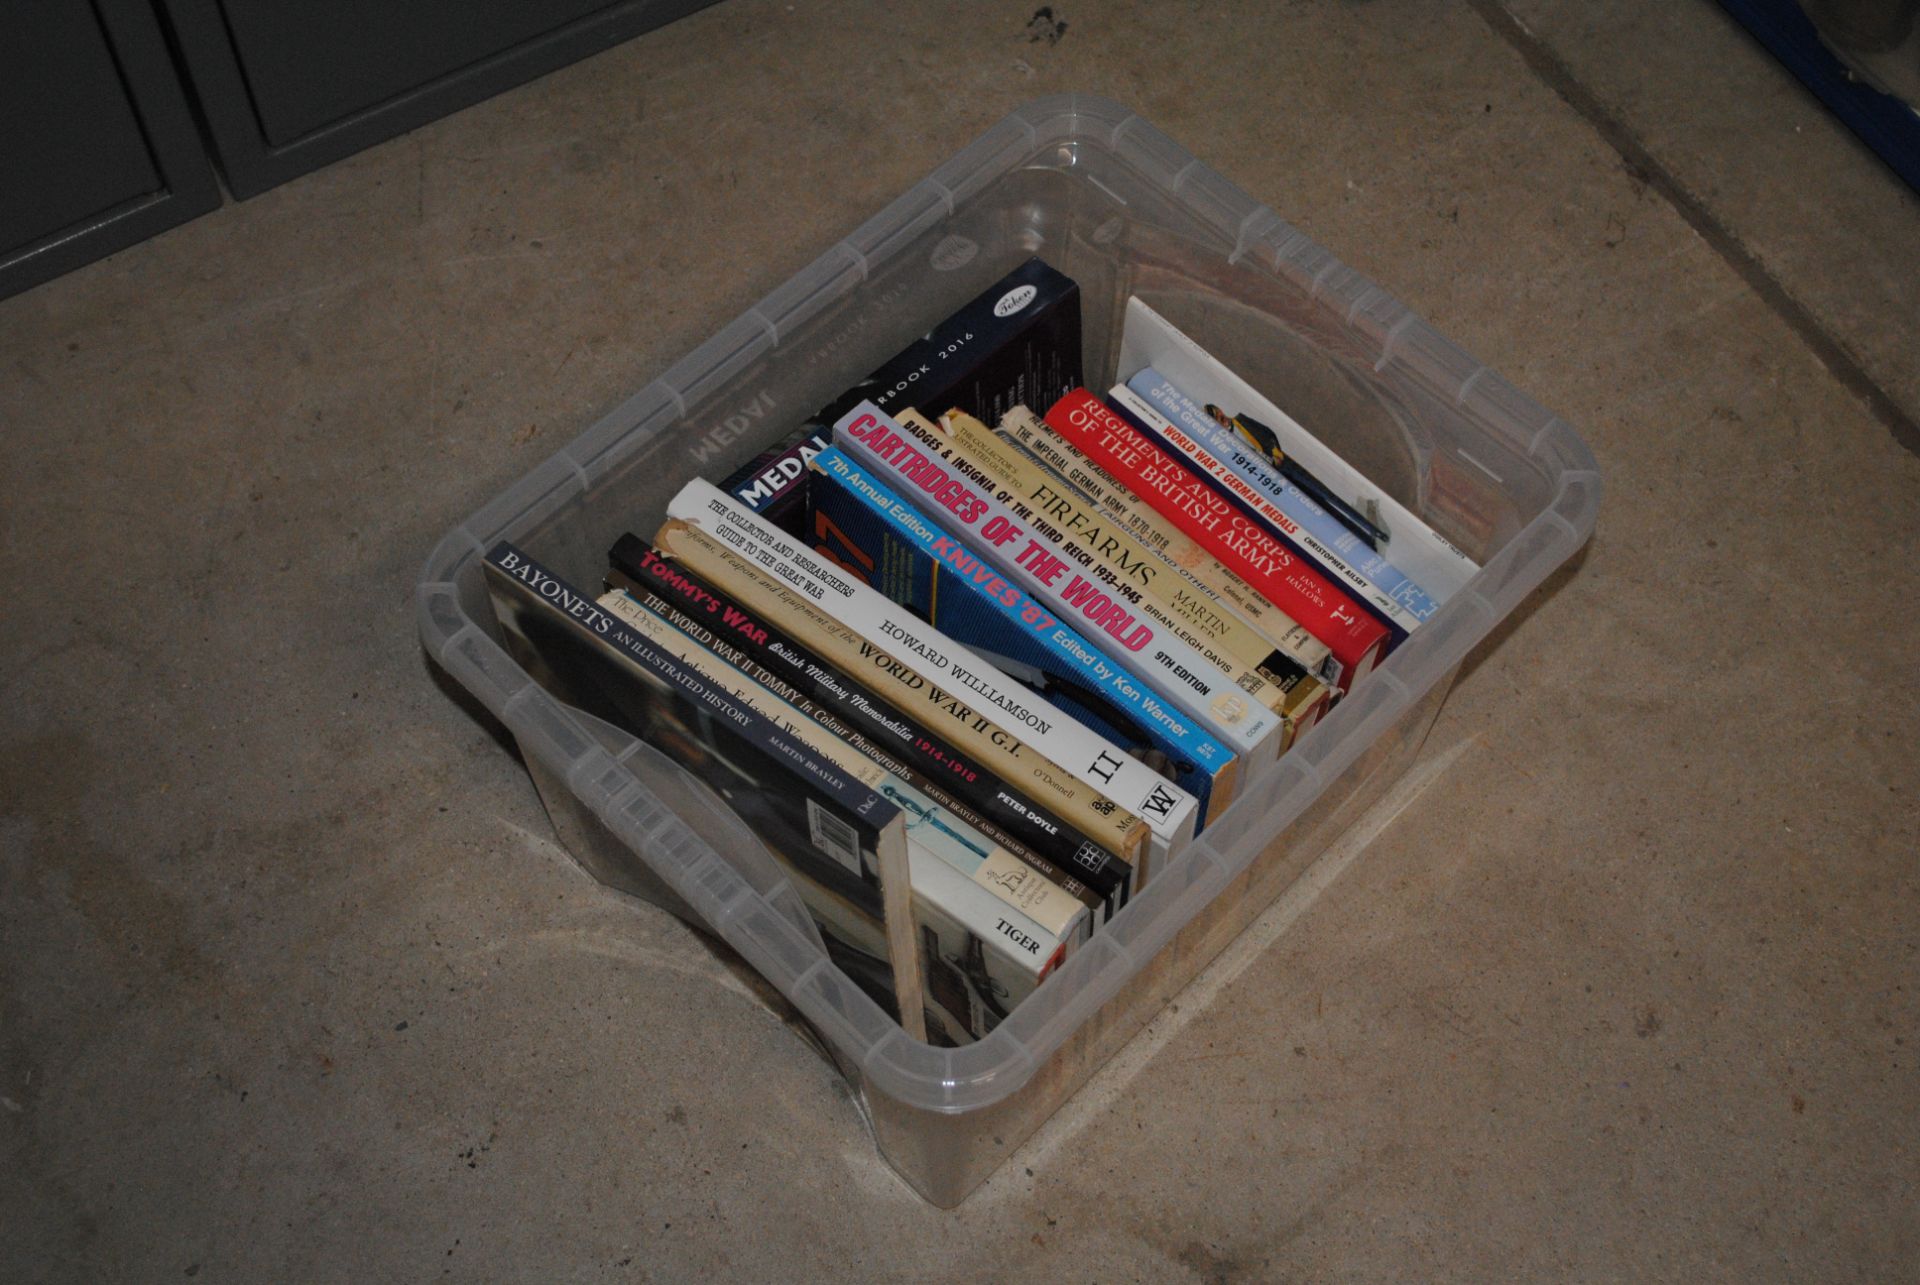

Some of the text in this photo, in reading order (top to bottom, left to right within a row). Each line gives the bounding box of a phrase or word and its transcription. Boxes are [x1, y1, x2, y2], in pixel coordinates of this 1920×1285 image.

[877, 363, 931, 406] RBOOK
[938, 332, 974, 359] 2016
[1158, 382, 1182, 401] The
[959, 427, 1019, 474] THE COLLECTOR'S
[988, 461, 1011, 479] GUIDE
[1010, 478, 1023, 488] TO
[1064, 444, 1083, 459] AND
[1150, 387, 1163, 398] of
[1159, 395, 1182, 413] the
[1178, 410, 1211, 437] Great
[1209, 434, 1233, 454] War
[1230, 452, 1283, 494] 1914-1918
[1163, 425, 1298, 534] WORLD WAR 2 GERMAN MEDALS
[826, 456, 936, 541] 7th Annual Edition
[903, 420, 943, 451] BADGES
[940, 448, 952, 458] &
[951, 456, 996, 492] INSIGNIA
[995, 490, 1013, 505] OF
[1011, 502, 1033, 520] THE
[1031, 518, 1064, 544] THIRD
[1062, 542, 1093, 566] REICH
[1015, 425, 1170, 551] THE IMPERIAL GERMAN ARMY 1870-1918
[1065, 409, 1098, 436] OF
[1094, 431, 1141, 469] THE
[1137, 465, 1220, 530] BRITISH
[1216, 527, 1282, 579] ARMY
[1081, 400, 1191, 484] REGIMENTS
[1184, 481, 1231, 515] AND
[1229, 517, 1294, 565] CORPS
[707, 500, 855, 598] THE COLLECTOR AND RESEARCHERS
[715, 524, 825, 598] GUIDE TO THE GREAT WAR
[845, 412, 989, 525] CARTRIDGES
[978, 514, 1024, 551] OF
[1013, 542, 1070, 587] THE
[1059, 577, 1155, 652] WORLD
[929, 537, 1022, 607] KNIVES
[1029, 485, 1157, 584] FIREARMS
[1302, 536, 1345, 571] CHRISTOPHER
[1343, 569, 1368, 589] AILSBY
[498, 552, 614, 634] BAYONETS
[613, 598, 636, 615] The
[632, 611, 664, 634] Price
[636, 550, 723, 614] TOMMY'S
[718, 606, 771, 646] WAR
[718, 552, 760, 580] Weapons
[758, 578, 779, 592] and
[776, 590, 833, 628] Equipment
[829, 625, 843, 634] of
[839, 632, 857, 644] the
[1172, 590, 1230, 635] MARTIN
[1284, 575, 1326, 608] HALLOWS
[1298, 575, 1324, 596] IAN S.
[611, 630, 633, 646] AN
[630, 642, 704, 694] ILLUSTRATED
[701, 691, 752, 727] HISTORY
[878, 620, 1052, 735] HOWARD WILLIAMSON
[1143, 603, 1233, 673] BRIAN LEIGH DAVIS
[1153, 650, 1211, 697] 9TH EDITION
[642, 594, 669, 614] THE
[667, 611, 713, 643] WORLD
[710, 640, 743, 664] WAR
[739, 660, 754, 671] II
[750, 667, 802, 704] TOMMY
[798, 700, 814, 712] In
[812, 709, 850, 737] Colour
[846, 733, 915, 782] Photographs
[767, 640, 915, 741] British Military Memorabilia
[856, 642, 1025, 757] WORLD WAR II G.I.
[1050, 630, 1191, 737] Edited by Ken Warner
[768, 735, 806, 763] MARTIN
[804, 760, 845, 790] BRAYLEY
[913, 736, 978, 784] 1914-1918
[1032, 766, 1075, 799] O'Donnell
[922, 783, 1053, 875] MARTIN BRAYLEY AND RICHARD INGRAM
[996, 791, 1058, 835] PETER DOYLE
[993, 917, 1041, 954] TIGER
